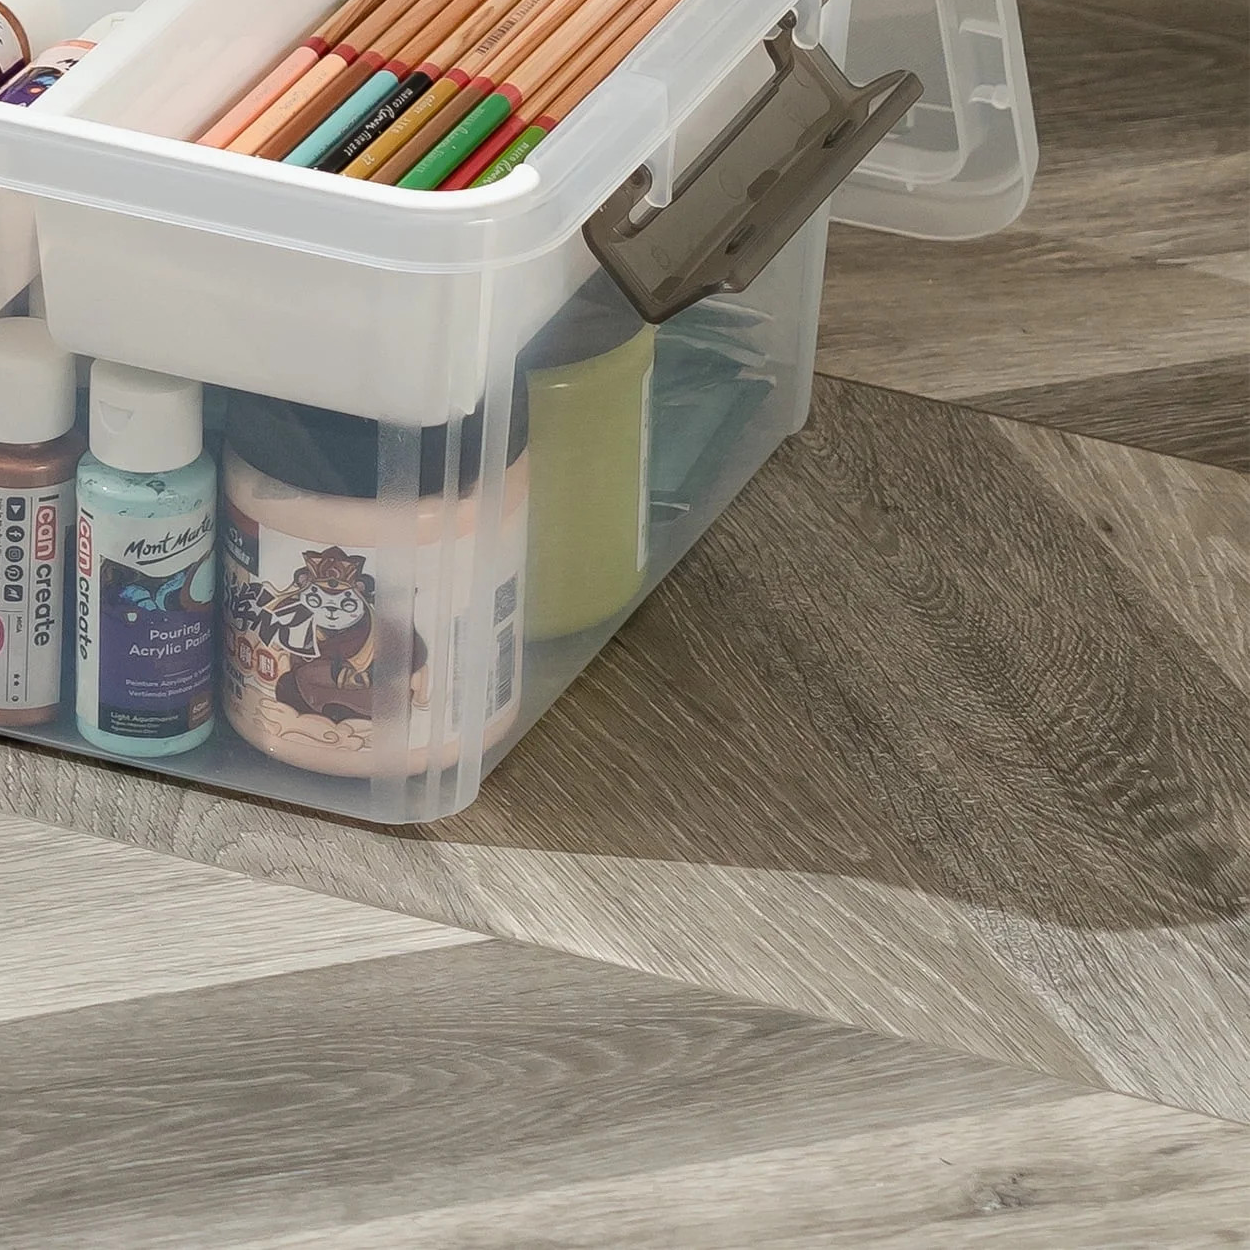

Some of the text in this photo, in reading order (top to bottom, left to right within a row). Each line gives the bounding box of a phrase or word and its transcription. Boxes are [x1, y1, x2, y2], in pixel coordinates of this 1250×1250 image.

[390, 86, 414, 109] marco
[341, 141, 359, 157] art
[352, 128, 373, 147] fine
[507, 141, 530, 163] marco
[36, 508, 54, 558] can
[79, 521, 92, 570] can
[124, 534, 174, 557] Mont
[33, 563, 55, 647] create
[78, 577, 93, 660] create
[150, 621, 201, 641] Pouring
[129, 642, 182, 659] Acrylic
